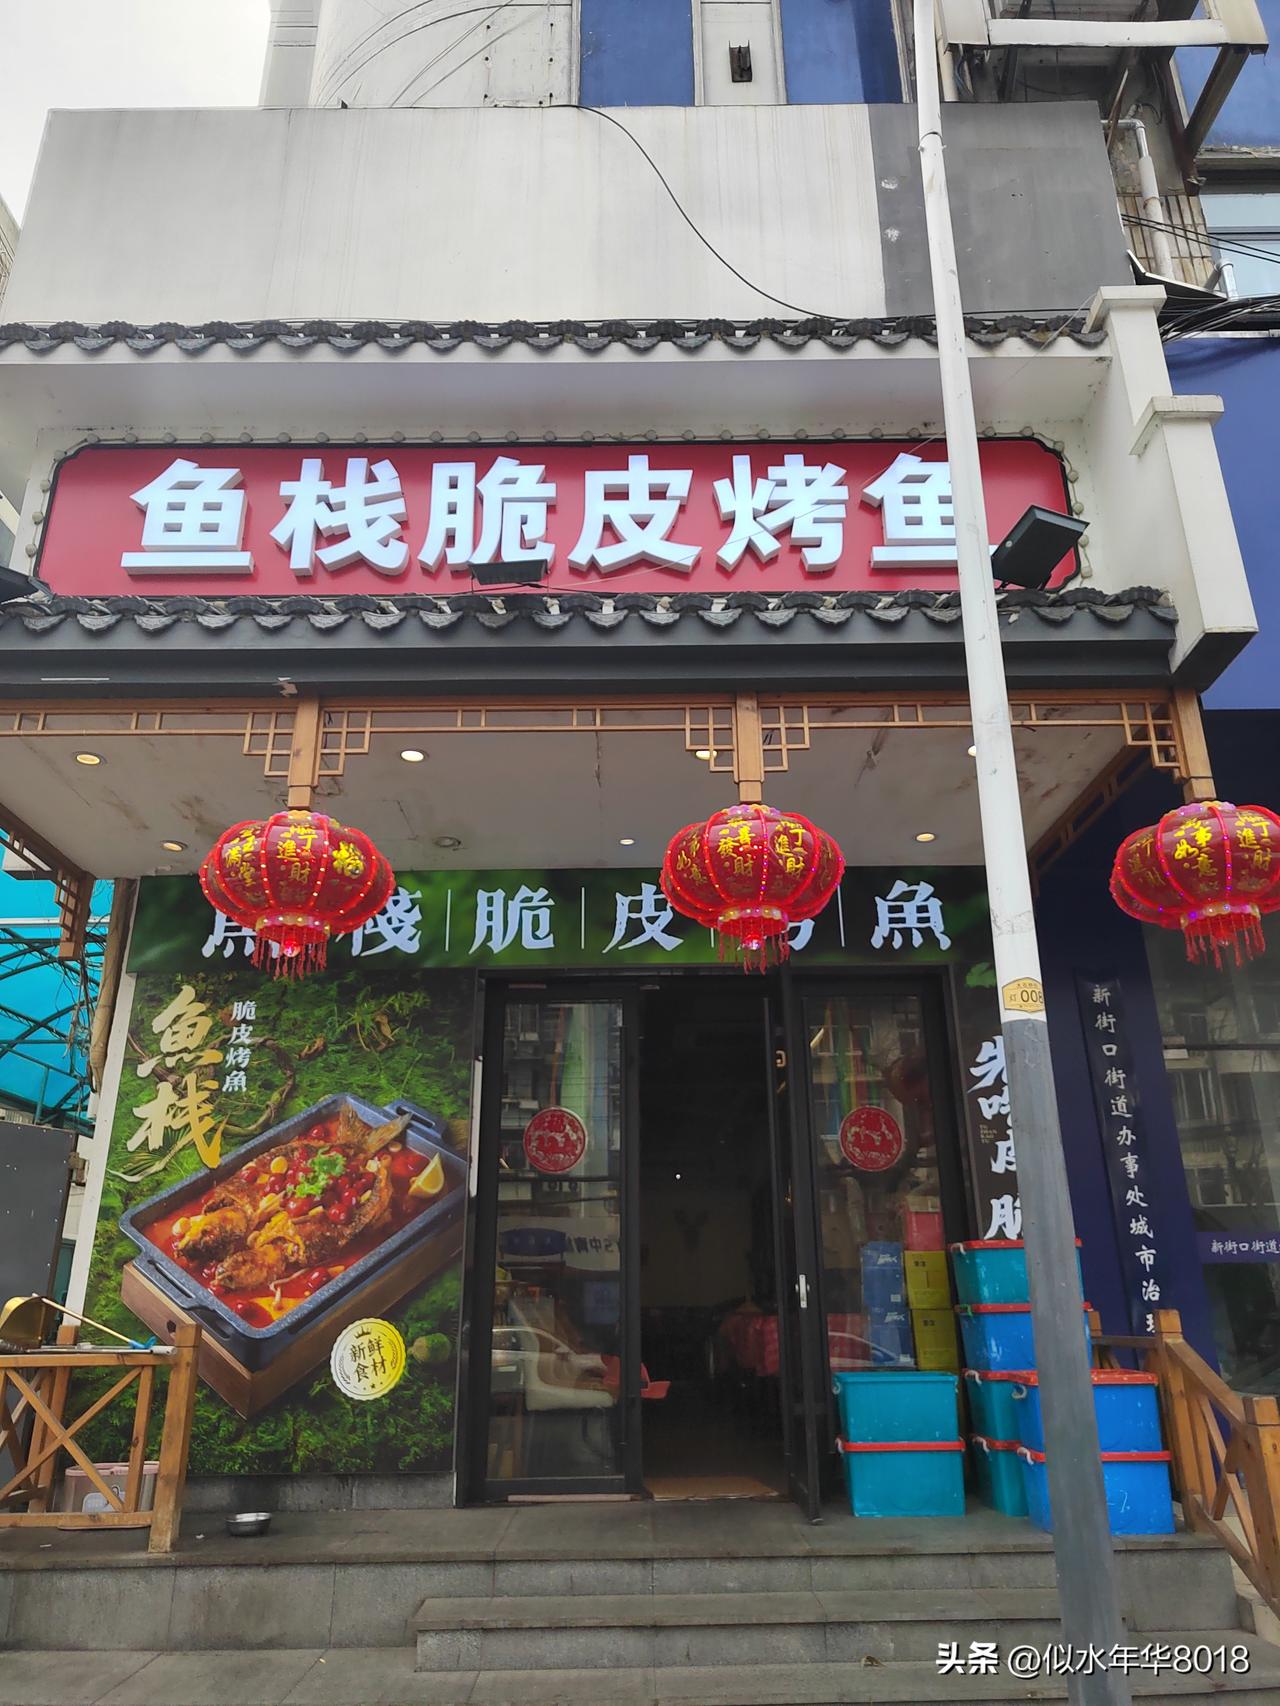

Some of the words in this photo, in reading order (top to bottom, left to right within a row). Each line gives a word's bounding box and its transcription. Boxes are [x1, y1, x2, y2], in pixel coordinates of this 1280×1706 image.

[120, 452, 998, 577] 鱼栈脆皮烤鱼
[221, 1001, 259, 1093] 脆皮烤魚
[1210, 1239, 1280, 1255] 新街口街道
[354, 1358, 389, 1384] 食材
